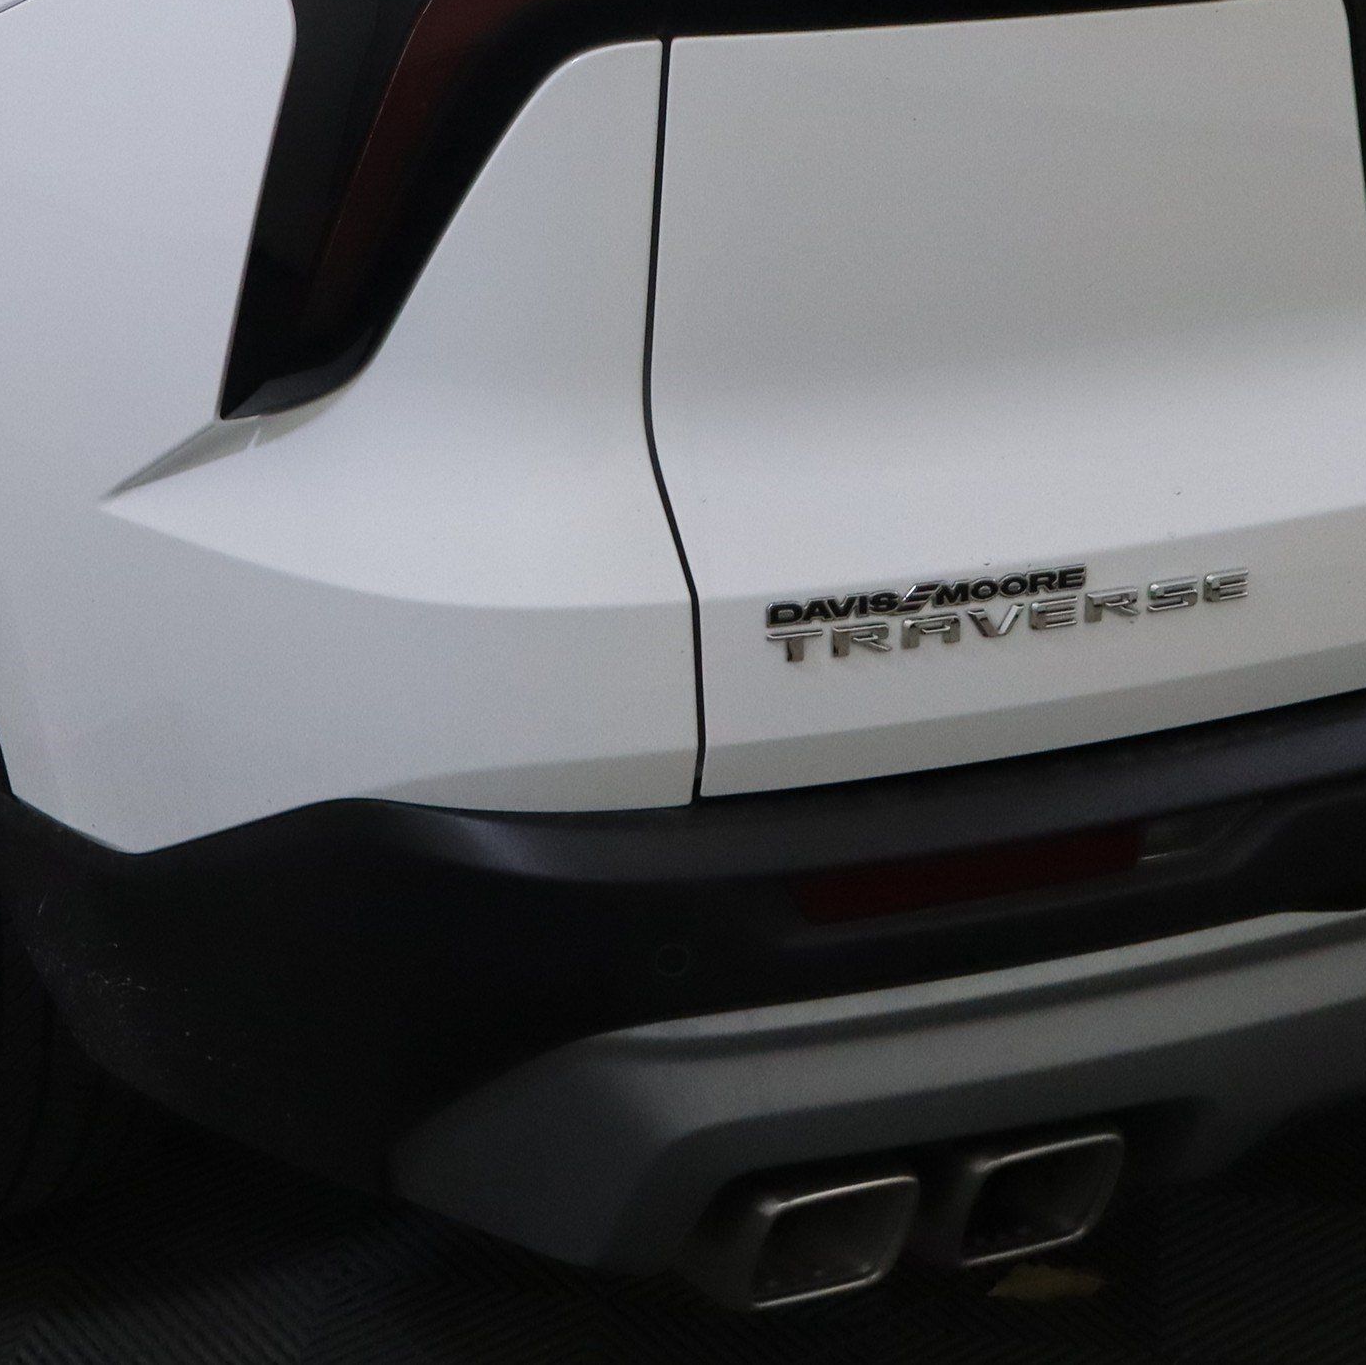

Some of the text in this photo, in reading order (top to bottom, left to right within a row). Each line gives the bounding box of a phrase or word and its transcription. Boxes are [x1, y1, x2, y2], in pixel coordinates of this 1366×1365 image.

[766, 564, 1087, 628] DAVIS MOORE
[766, 566, 1250, 663] TRAVERSE
